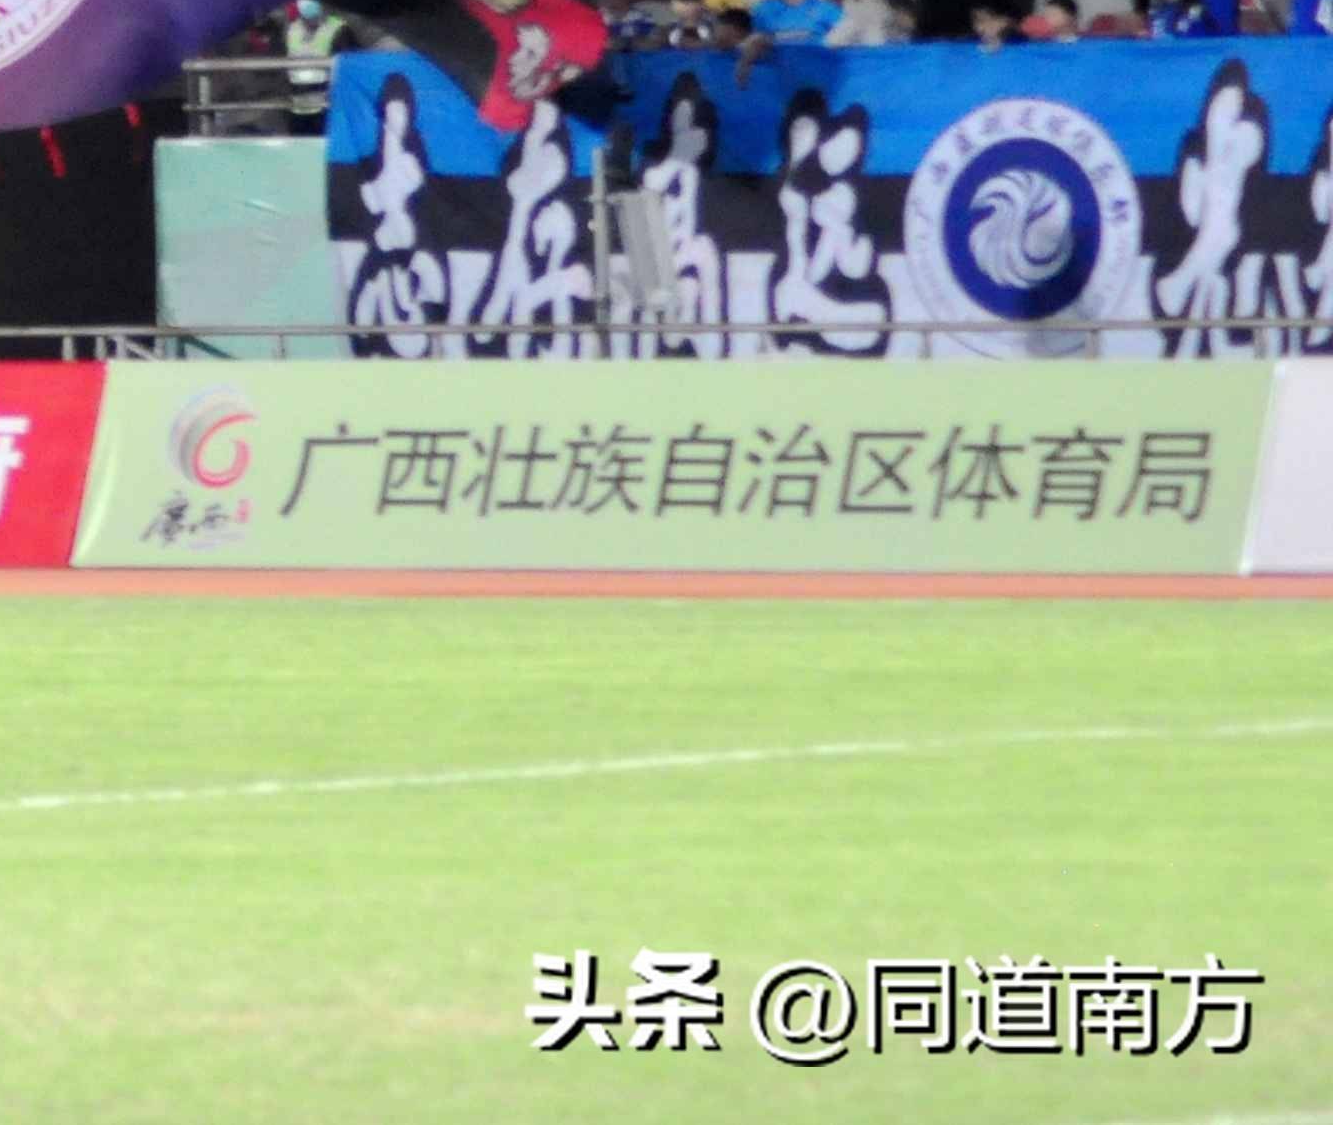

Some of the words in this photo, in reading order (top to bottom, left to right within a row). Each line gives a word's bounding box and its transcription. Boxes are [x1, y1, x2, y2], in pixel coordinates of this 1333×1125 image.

[279, 421, 1214, 523] 广西壮族自治区体育局
